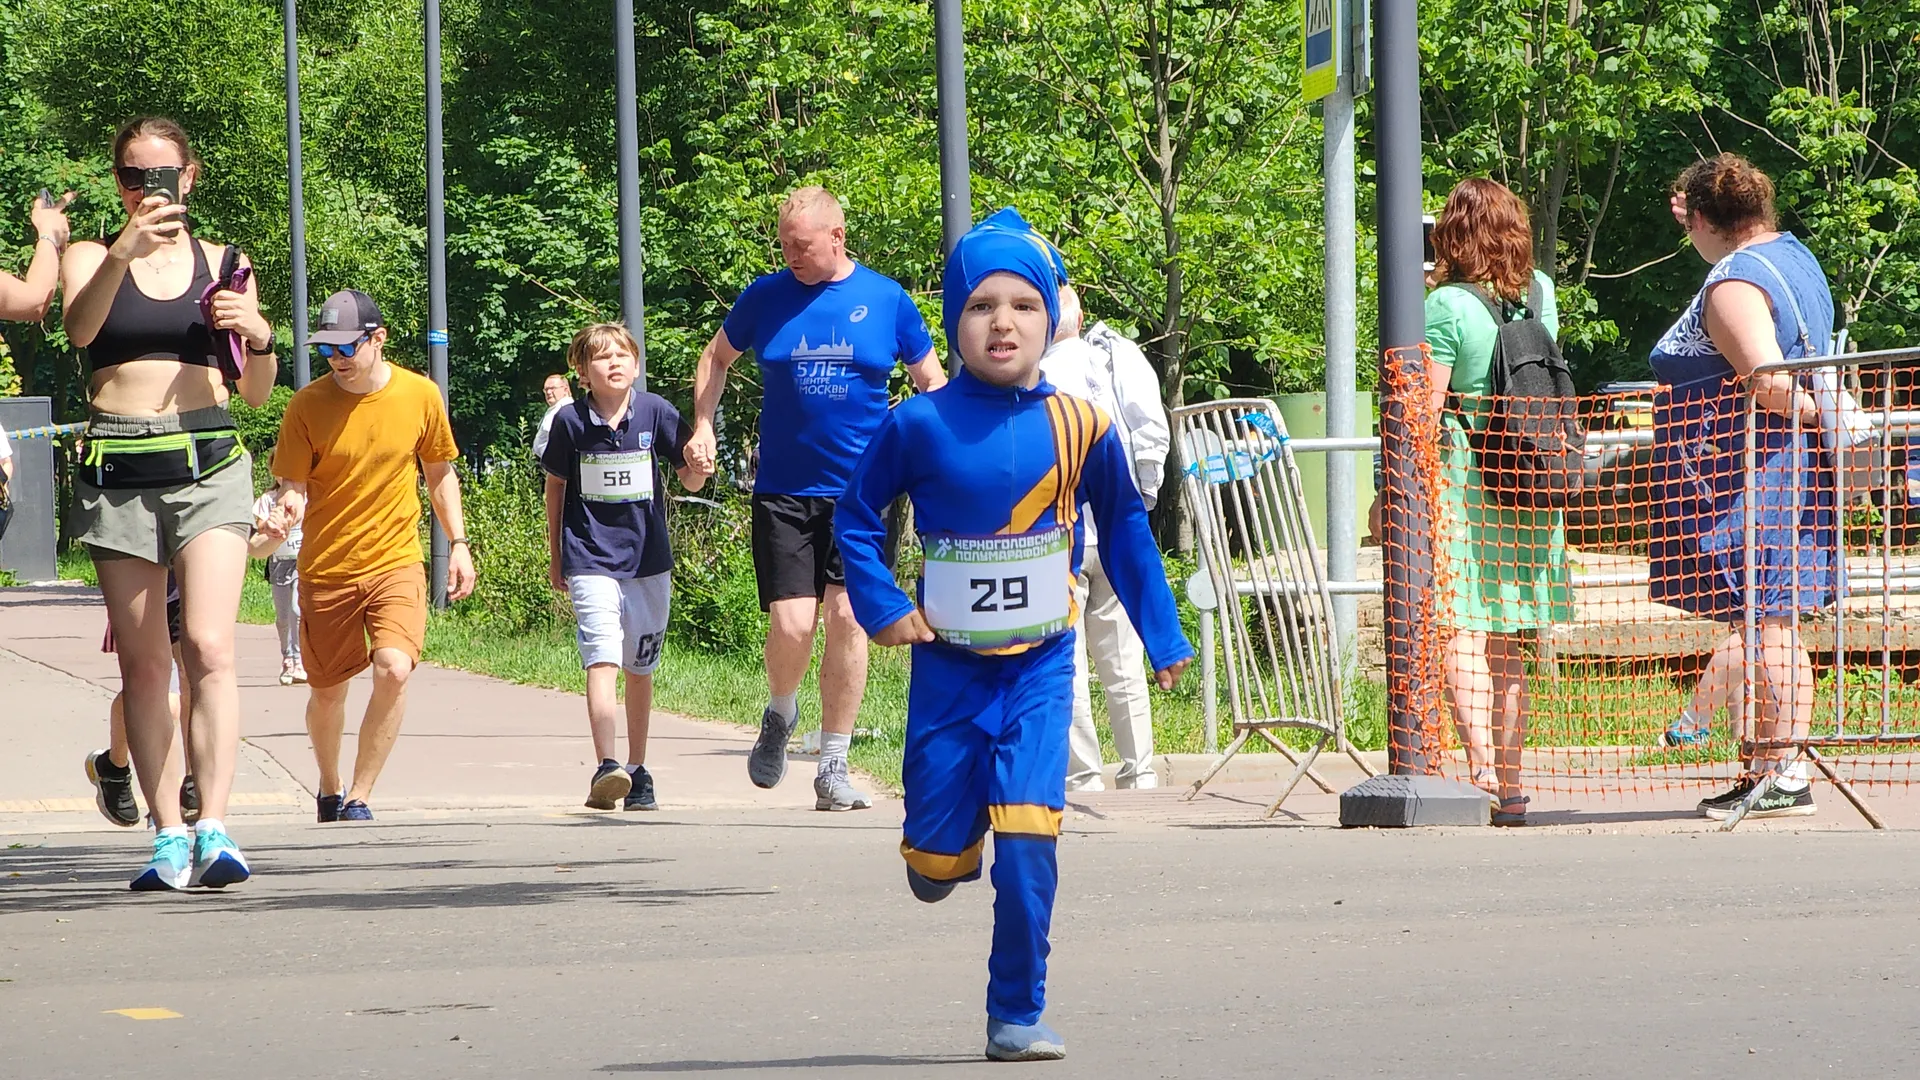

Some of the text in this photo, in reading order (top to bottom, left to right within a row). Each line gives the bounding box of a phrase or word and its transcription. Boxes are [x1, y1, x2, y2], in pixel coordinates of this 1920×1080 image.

[797, 361, 853, 377] 5 ЛЕТ
[799, 384, 849, 395] МОСКВЫ
[603, 470, 631, 486] 58
[954, 527, 1061, 550] ЧЕРНОГОЛОВСКИЙ
[955, 547, 1048, 562] ПОЛУМАРАФОН
[970, 575, 1029, 612] 29
